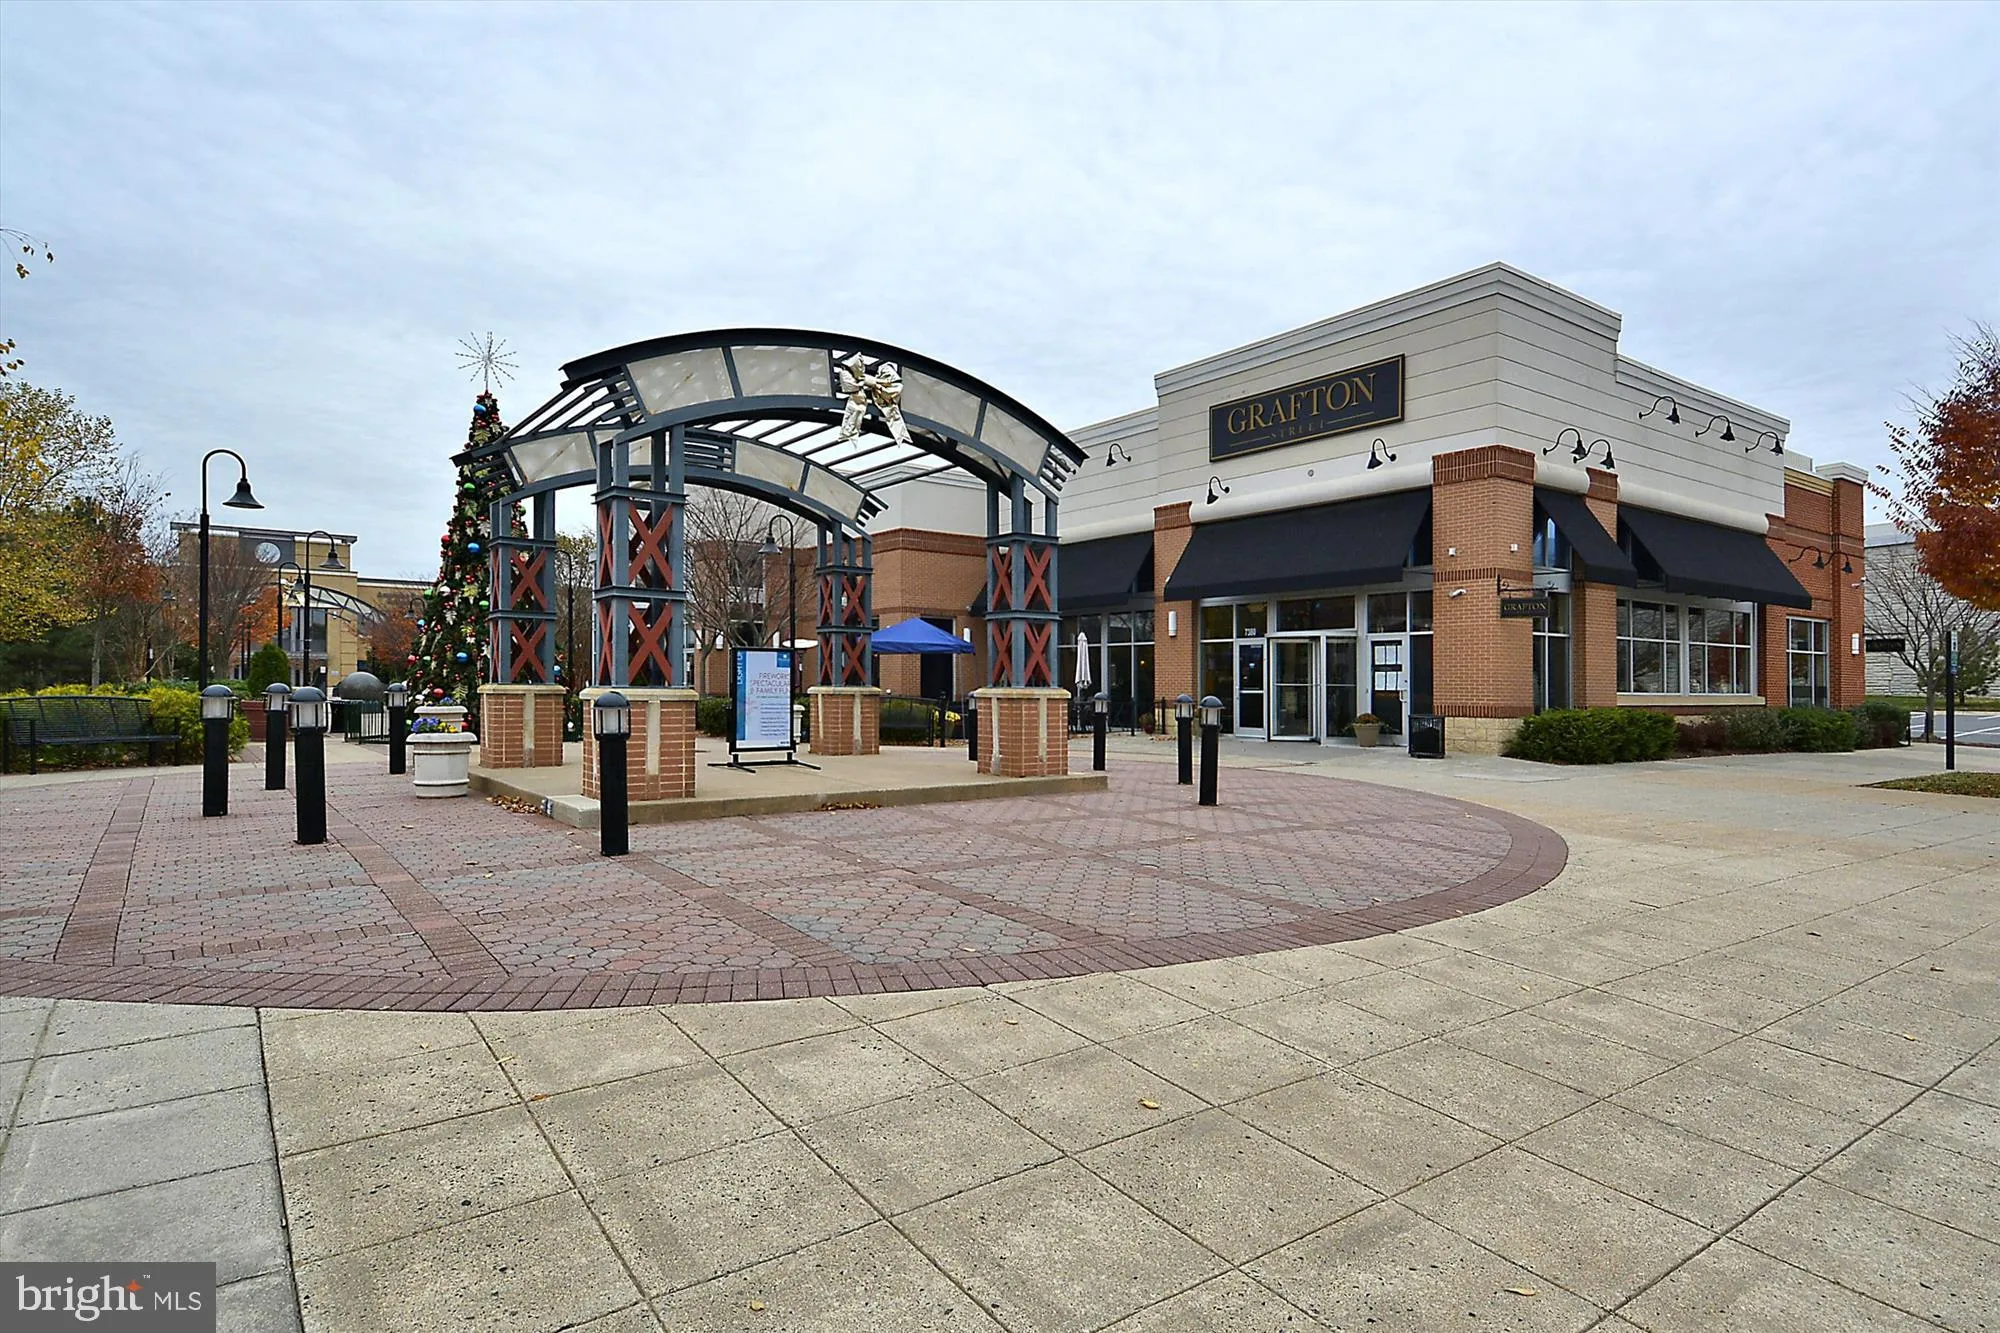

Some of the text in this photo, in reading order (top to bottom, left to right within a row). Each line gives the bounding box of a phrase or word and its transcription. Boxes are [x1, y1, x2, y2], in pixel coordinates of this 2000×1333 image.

[1228, 373, 1376, 434] GRAFTON
[1270, 420, 1324, 438] STREET
[1503, 601, 1547, 611] GRAFTON
[758, 672, 790, 680] FIREWORK
